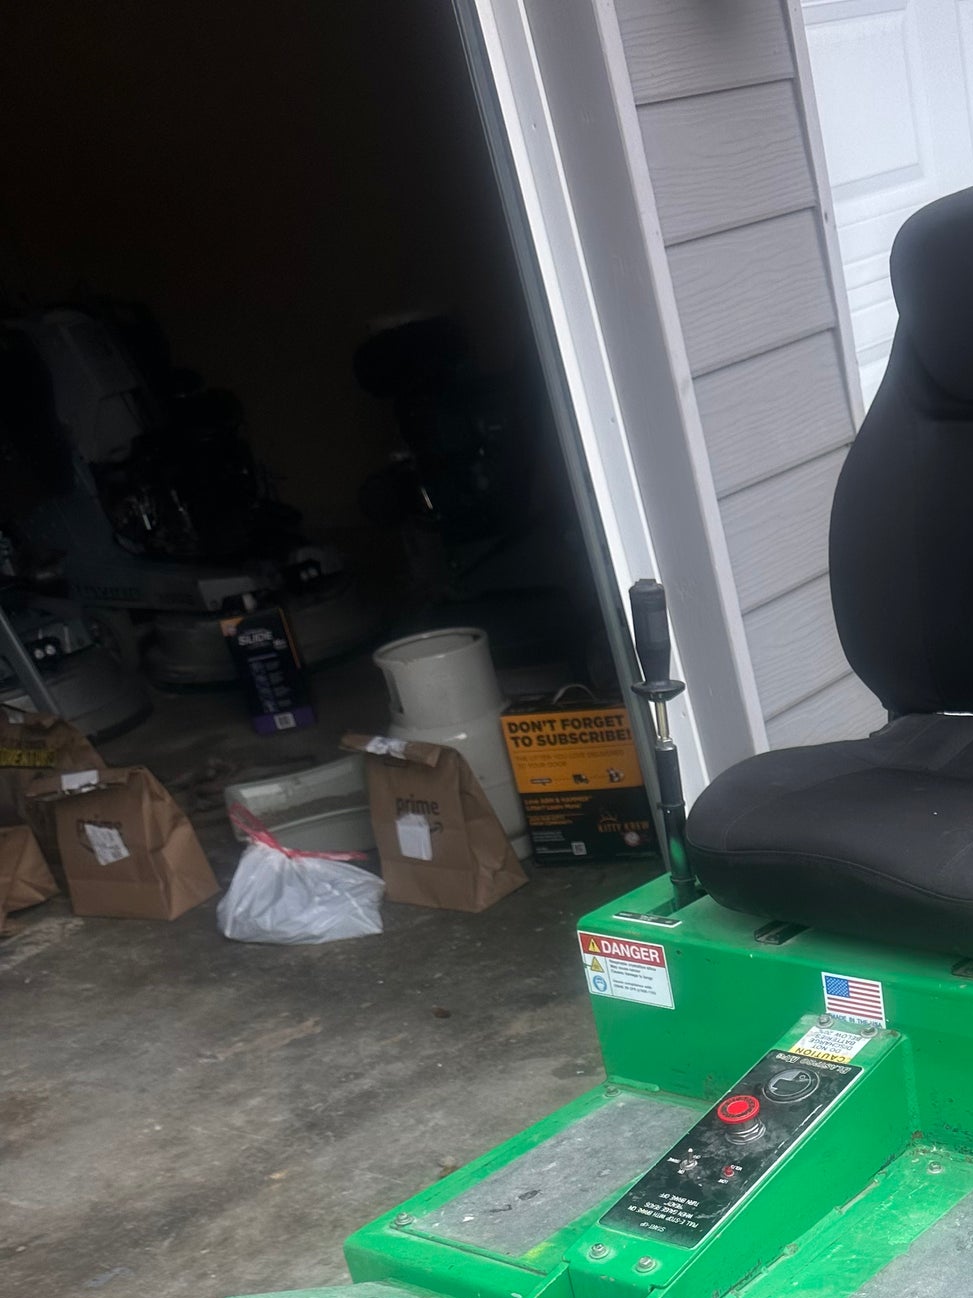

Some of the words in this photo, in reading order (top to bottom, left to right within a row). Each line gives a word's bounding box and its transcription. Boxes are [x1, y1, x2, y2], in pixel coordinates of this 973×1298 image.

[507, 719, 557, 735] DON'T
[561, 714, 625, 732] FORGET
[510, 735, 533, 748] TO
[537, 729, 633, 747] SUBSCRIBE!
[600, 940, 661, 963] DANGER
[794, 1047, 846, 1063] CAUTION
[811, 1044, 828, 1052] NOT
